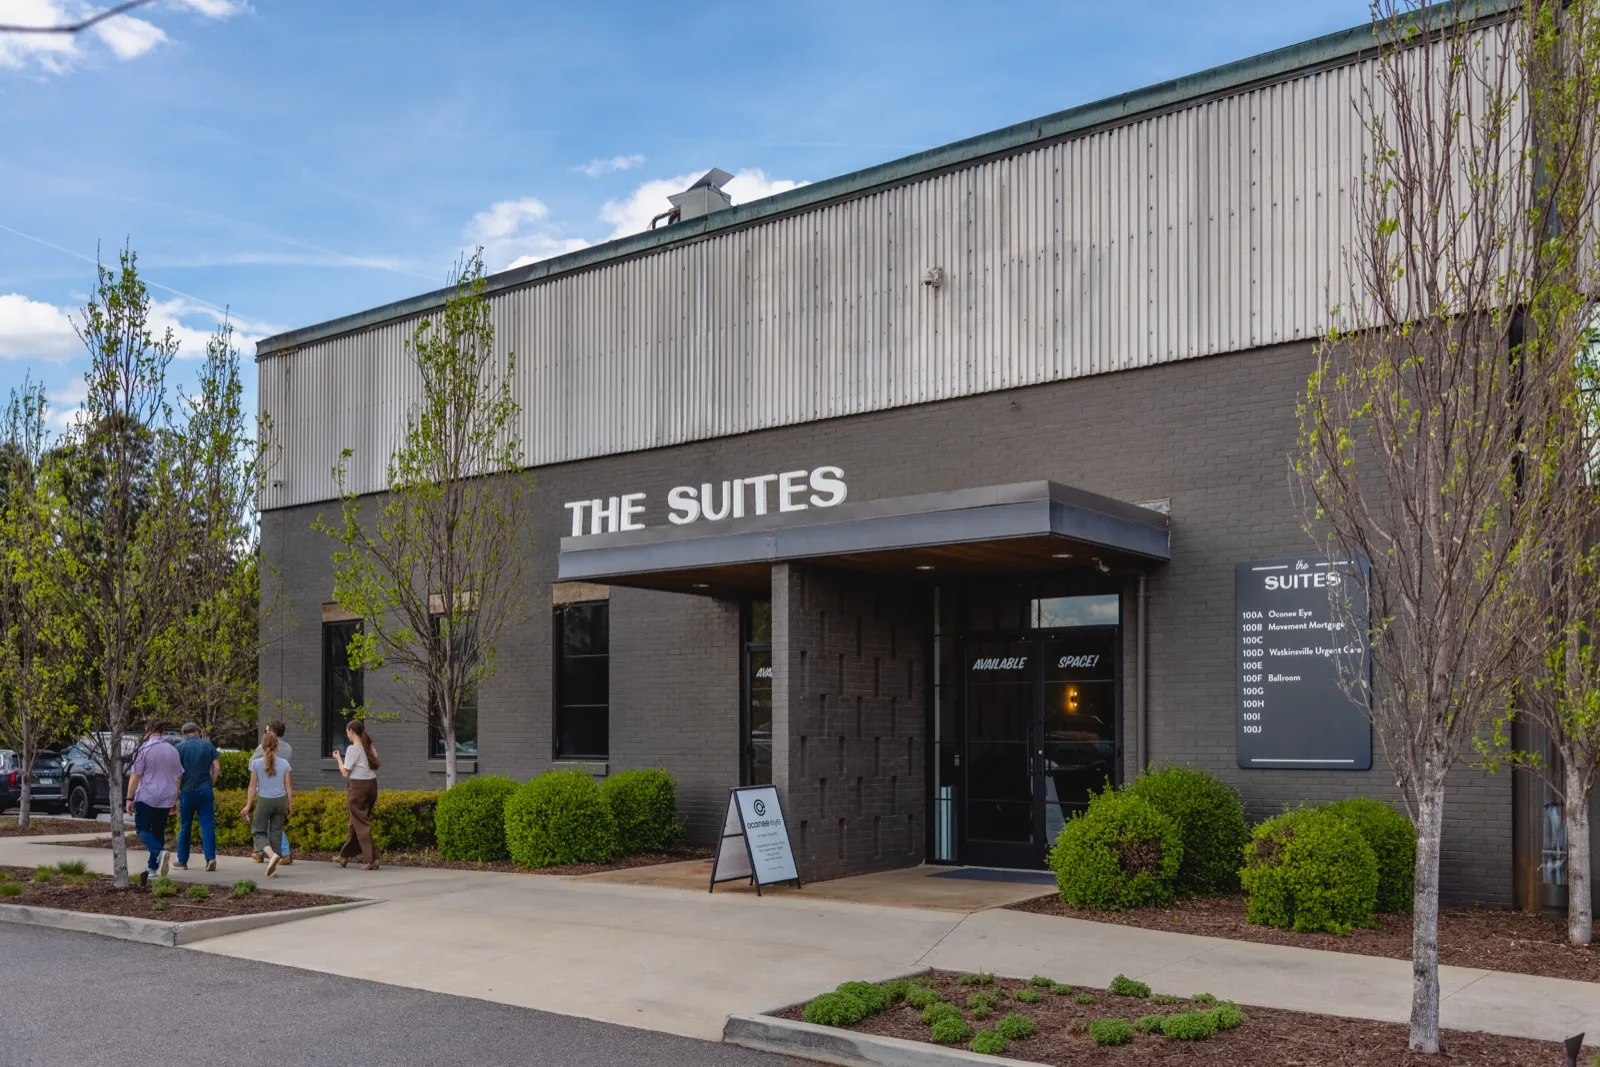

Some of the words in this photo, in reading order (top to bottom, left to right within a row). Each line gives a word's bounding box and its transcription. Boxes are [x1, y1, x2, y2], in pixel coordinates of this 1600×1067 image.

[564, 492, 647, 537] THE
[667, 466, 848, 525] SUITES
[1295, 560, 1309, 570] the
[1264, 572, 1341, 590] SUITES
[1242, 611, 1263, 619] 100A
[1268, 610, 1297, 618] Oconee
[1298, 608, 1312, 618] Eye
[1242, 623, 1263, 632] 100B
[1268, 622, 1307, 631] Movement
[1242, 636, 1263, 645] 100C
[1242, 649, 1264, 657] 100D
[1269, 647, 1313, 656] Watkinsville
[972, 657, 1027, 670] AVAILABLE
[1058, 655, 1099, 668] SPACE!
[1242, 662, 1263, 670] 100E
[1243, 675, 1263, 683] 100F
[1268, 674, 1301, 682] Ballroom
[1243, 687, 1264, 696] 100G
[1243, 700, 1265, 708] 100H
[1243, 726, 1262, 734] 100J
[747, 821, 770, 829] oconee
